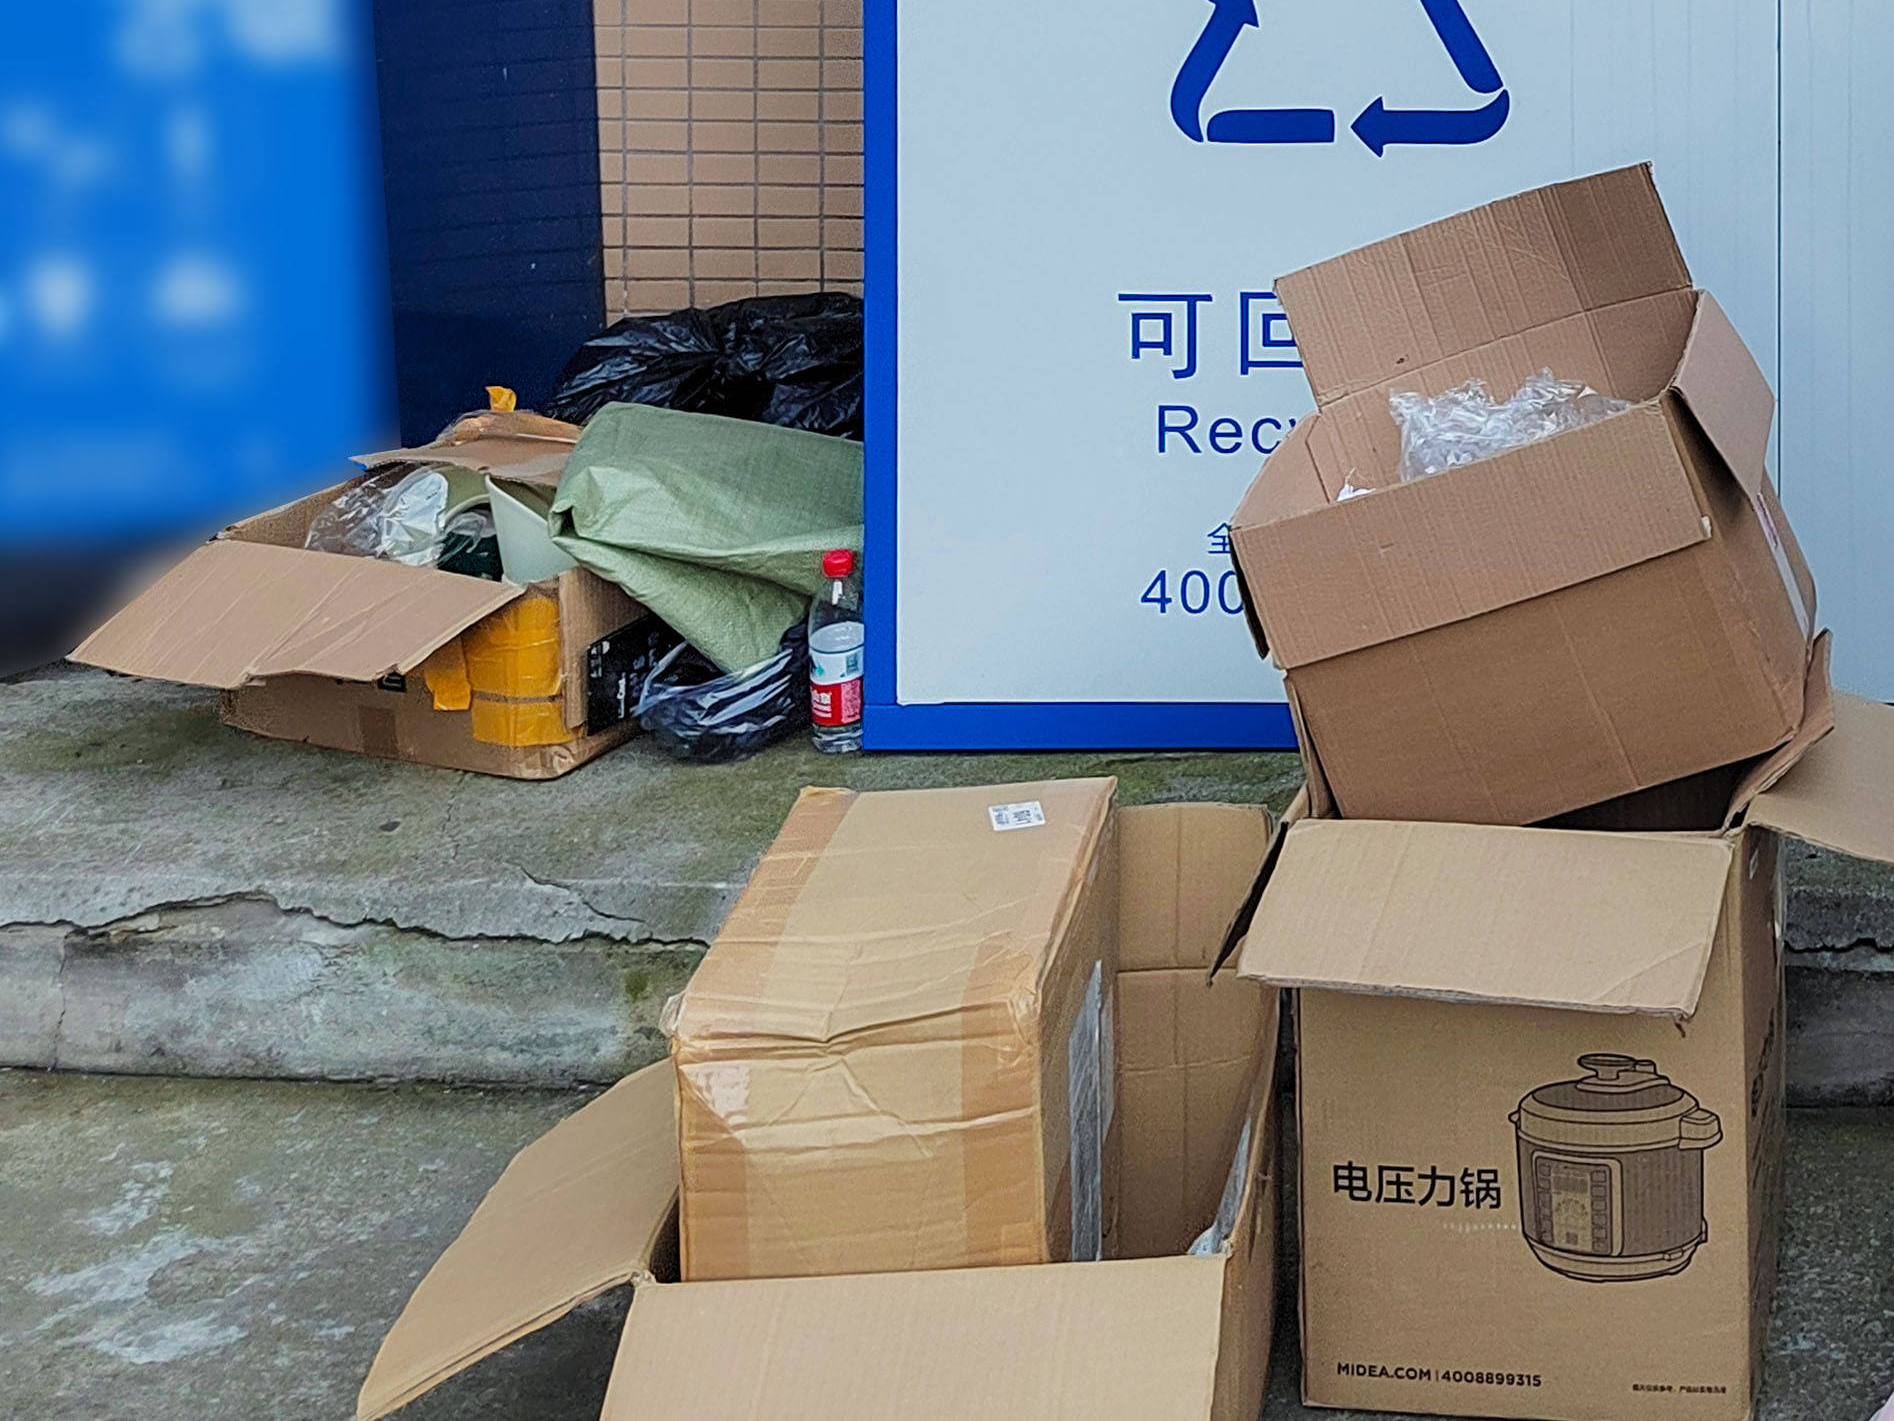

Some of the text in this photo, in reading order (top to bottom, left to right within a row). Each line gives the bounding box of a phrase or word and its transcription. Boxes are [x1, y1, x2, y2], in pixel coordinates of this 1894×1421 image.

[1118, 292, 1304, 379] 可回
[1157, 404, 1296, 455] Rec
[1140, 570, 1243, 614] 400
[1332, 1161, 1501, 1209] 电压力锅
[1337, 1362, 1541, 1387] MIDEA.COM 4008899315
